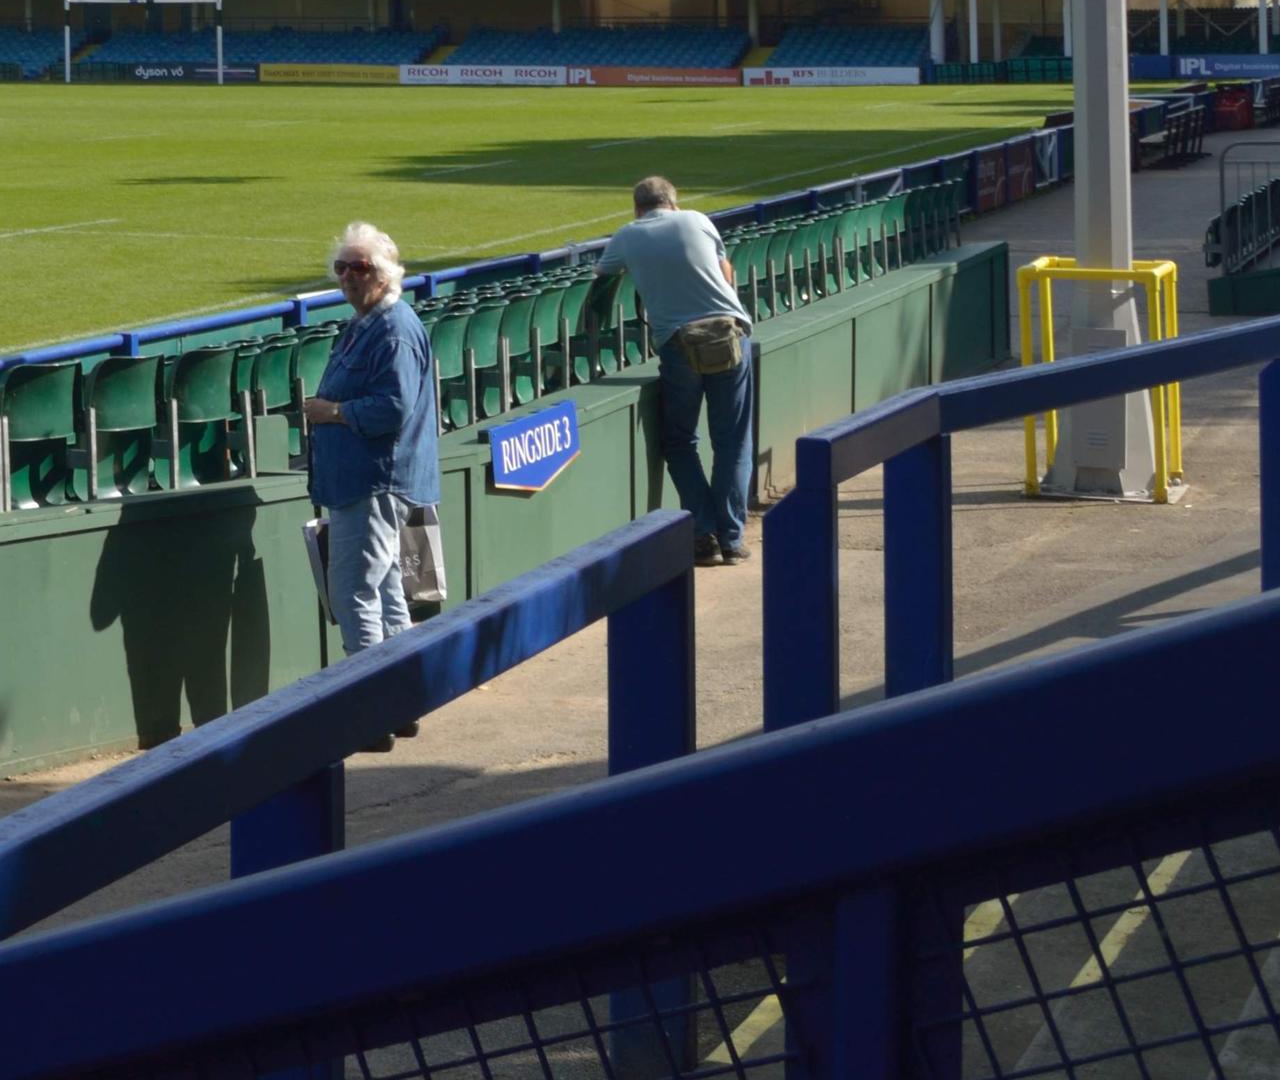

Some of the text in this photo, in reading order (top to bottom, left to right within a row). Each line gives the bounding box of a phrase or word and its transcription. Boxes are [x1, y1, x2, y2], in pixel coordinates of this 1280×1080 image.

[135, 65, 168, 79] dyson
[407, 67, 448, 77] RICOH
[460, 68, 503, 78] RICOH
[1180, 58, 1212, 75] IPL
[514, 69, 557, 79] RICOH
[570, 68, 596, 85] IPL
[501, 415, 571, 475] RINGSIDE 3
